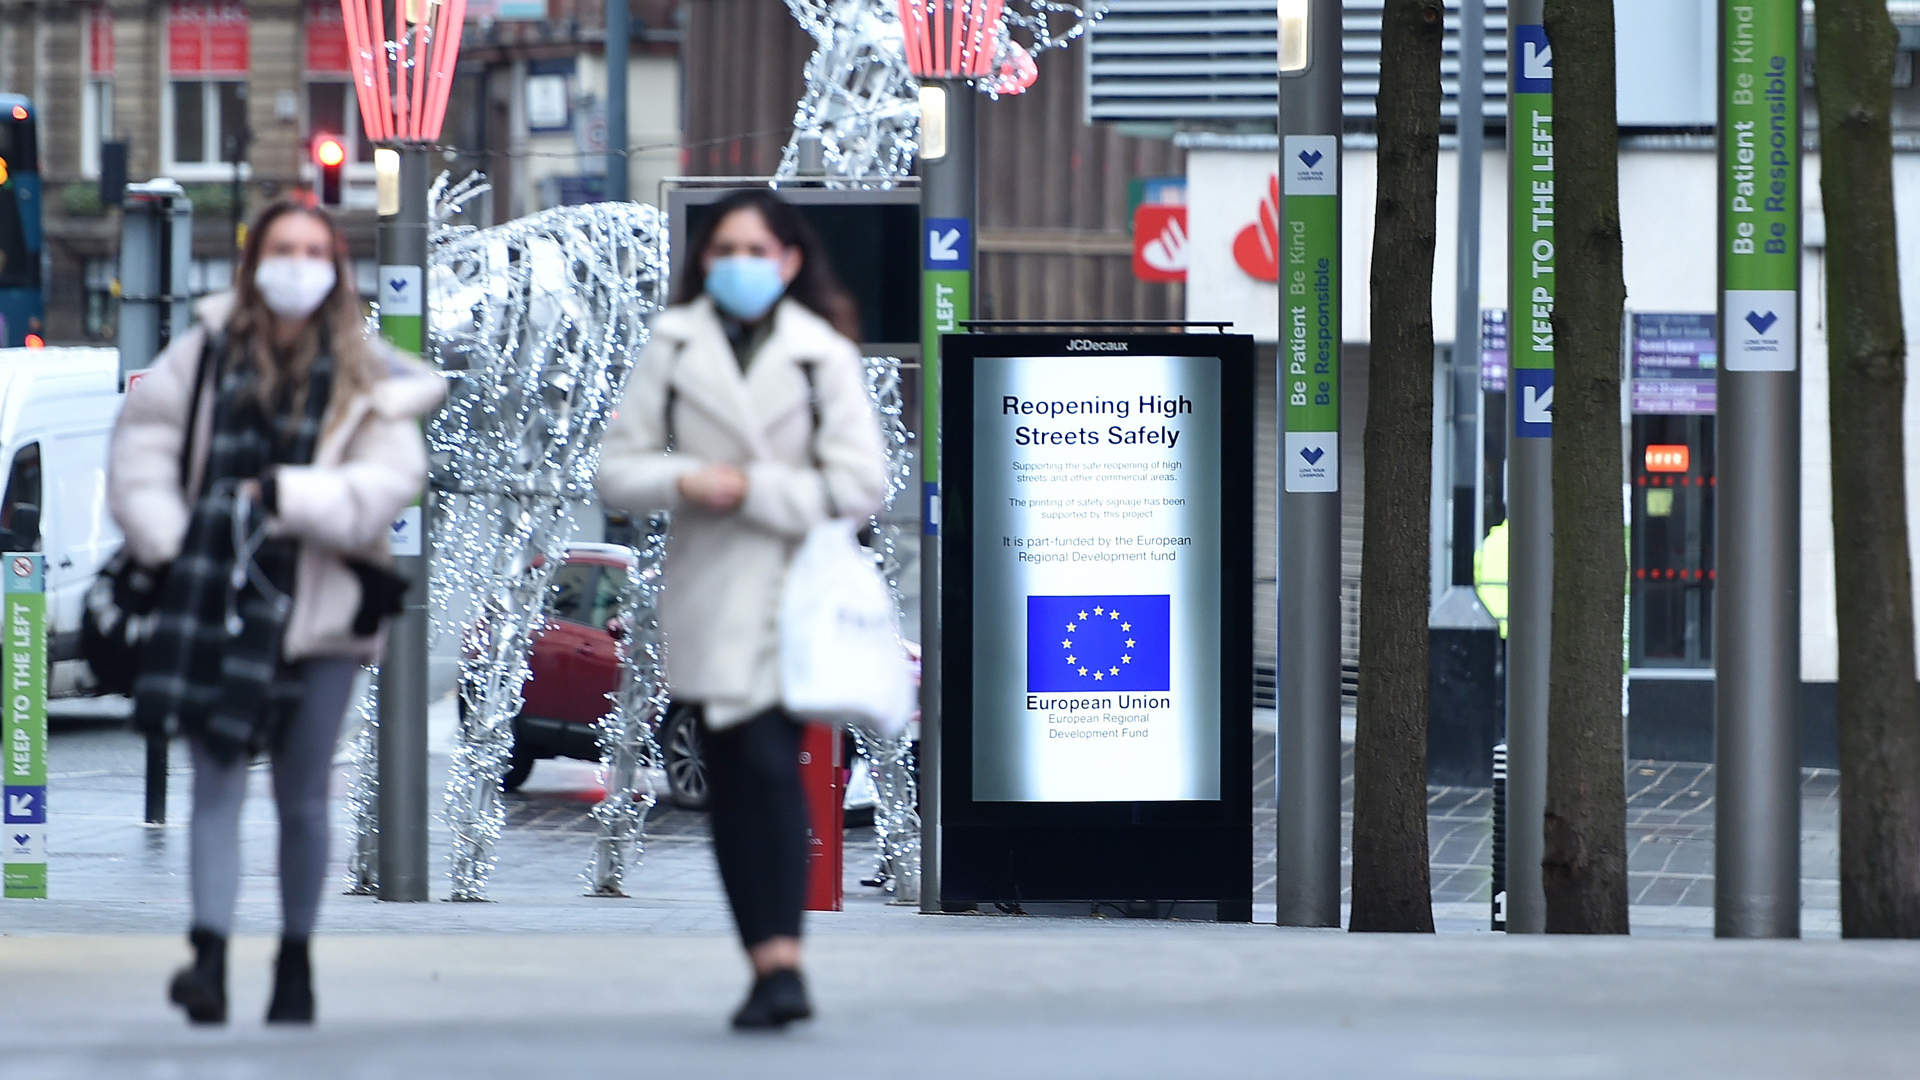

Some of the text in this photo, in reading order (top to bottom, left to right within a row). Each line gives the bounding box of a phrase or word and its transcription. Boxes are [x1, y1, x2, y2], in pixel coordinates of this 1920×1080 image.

[1732, 6, 1755, 254] Be Patient Be Kind
[1764, 55, 1790, 254] Be Responsible
[1532, 110, 1555, 352] KEEP TO THE LEFT
[936, 282, 954, 332] LEFT
[1290, 221, 1307, 406] Be Patient Be Kind
[1314, 257, 1333, 406] Be Responsible
[1066, 339, 1129, 351] JCDecaux
[1002, 395, 1192, 418] Reopening High
[1015, 426, 1180, 448] Streets Safely
[1012, 461, 1182, 473] Supporting the safe reopening of high
[1017, 474, 1048, 482] streets
[1050, 474, 1067, 482] and
[1070, 474, 1093, 482] other
[1095, 473, 1147, 482] commercial
[1009, 497, 1186, 508] The printing of safety signage has been
[1042, 510, 1153, 519] supported by this project
[1003, 535, 1192, 549] It is part-funded by the European
[1018, 551, 1176, 564] Regional Development fund
[13, 602, 31, 647] LEFT
[13, 652, 31, 690] THE
[13, 694, 31, 723] TO
[1026, 695, 1170, 713] European Union
[1048, 713, 1149, 725] European Regional
[1049, 728, 1148, 739] Development Fund
[13, 728, 31, 777] KEEP
